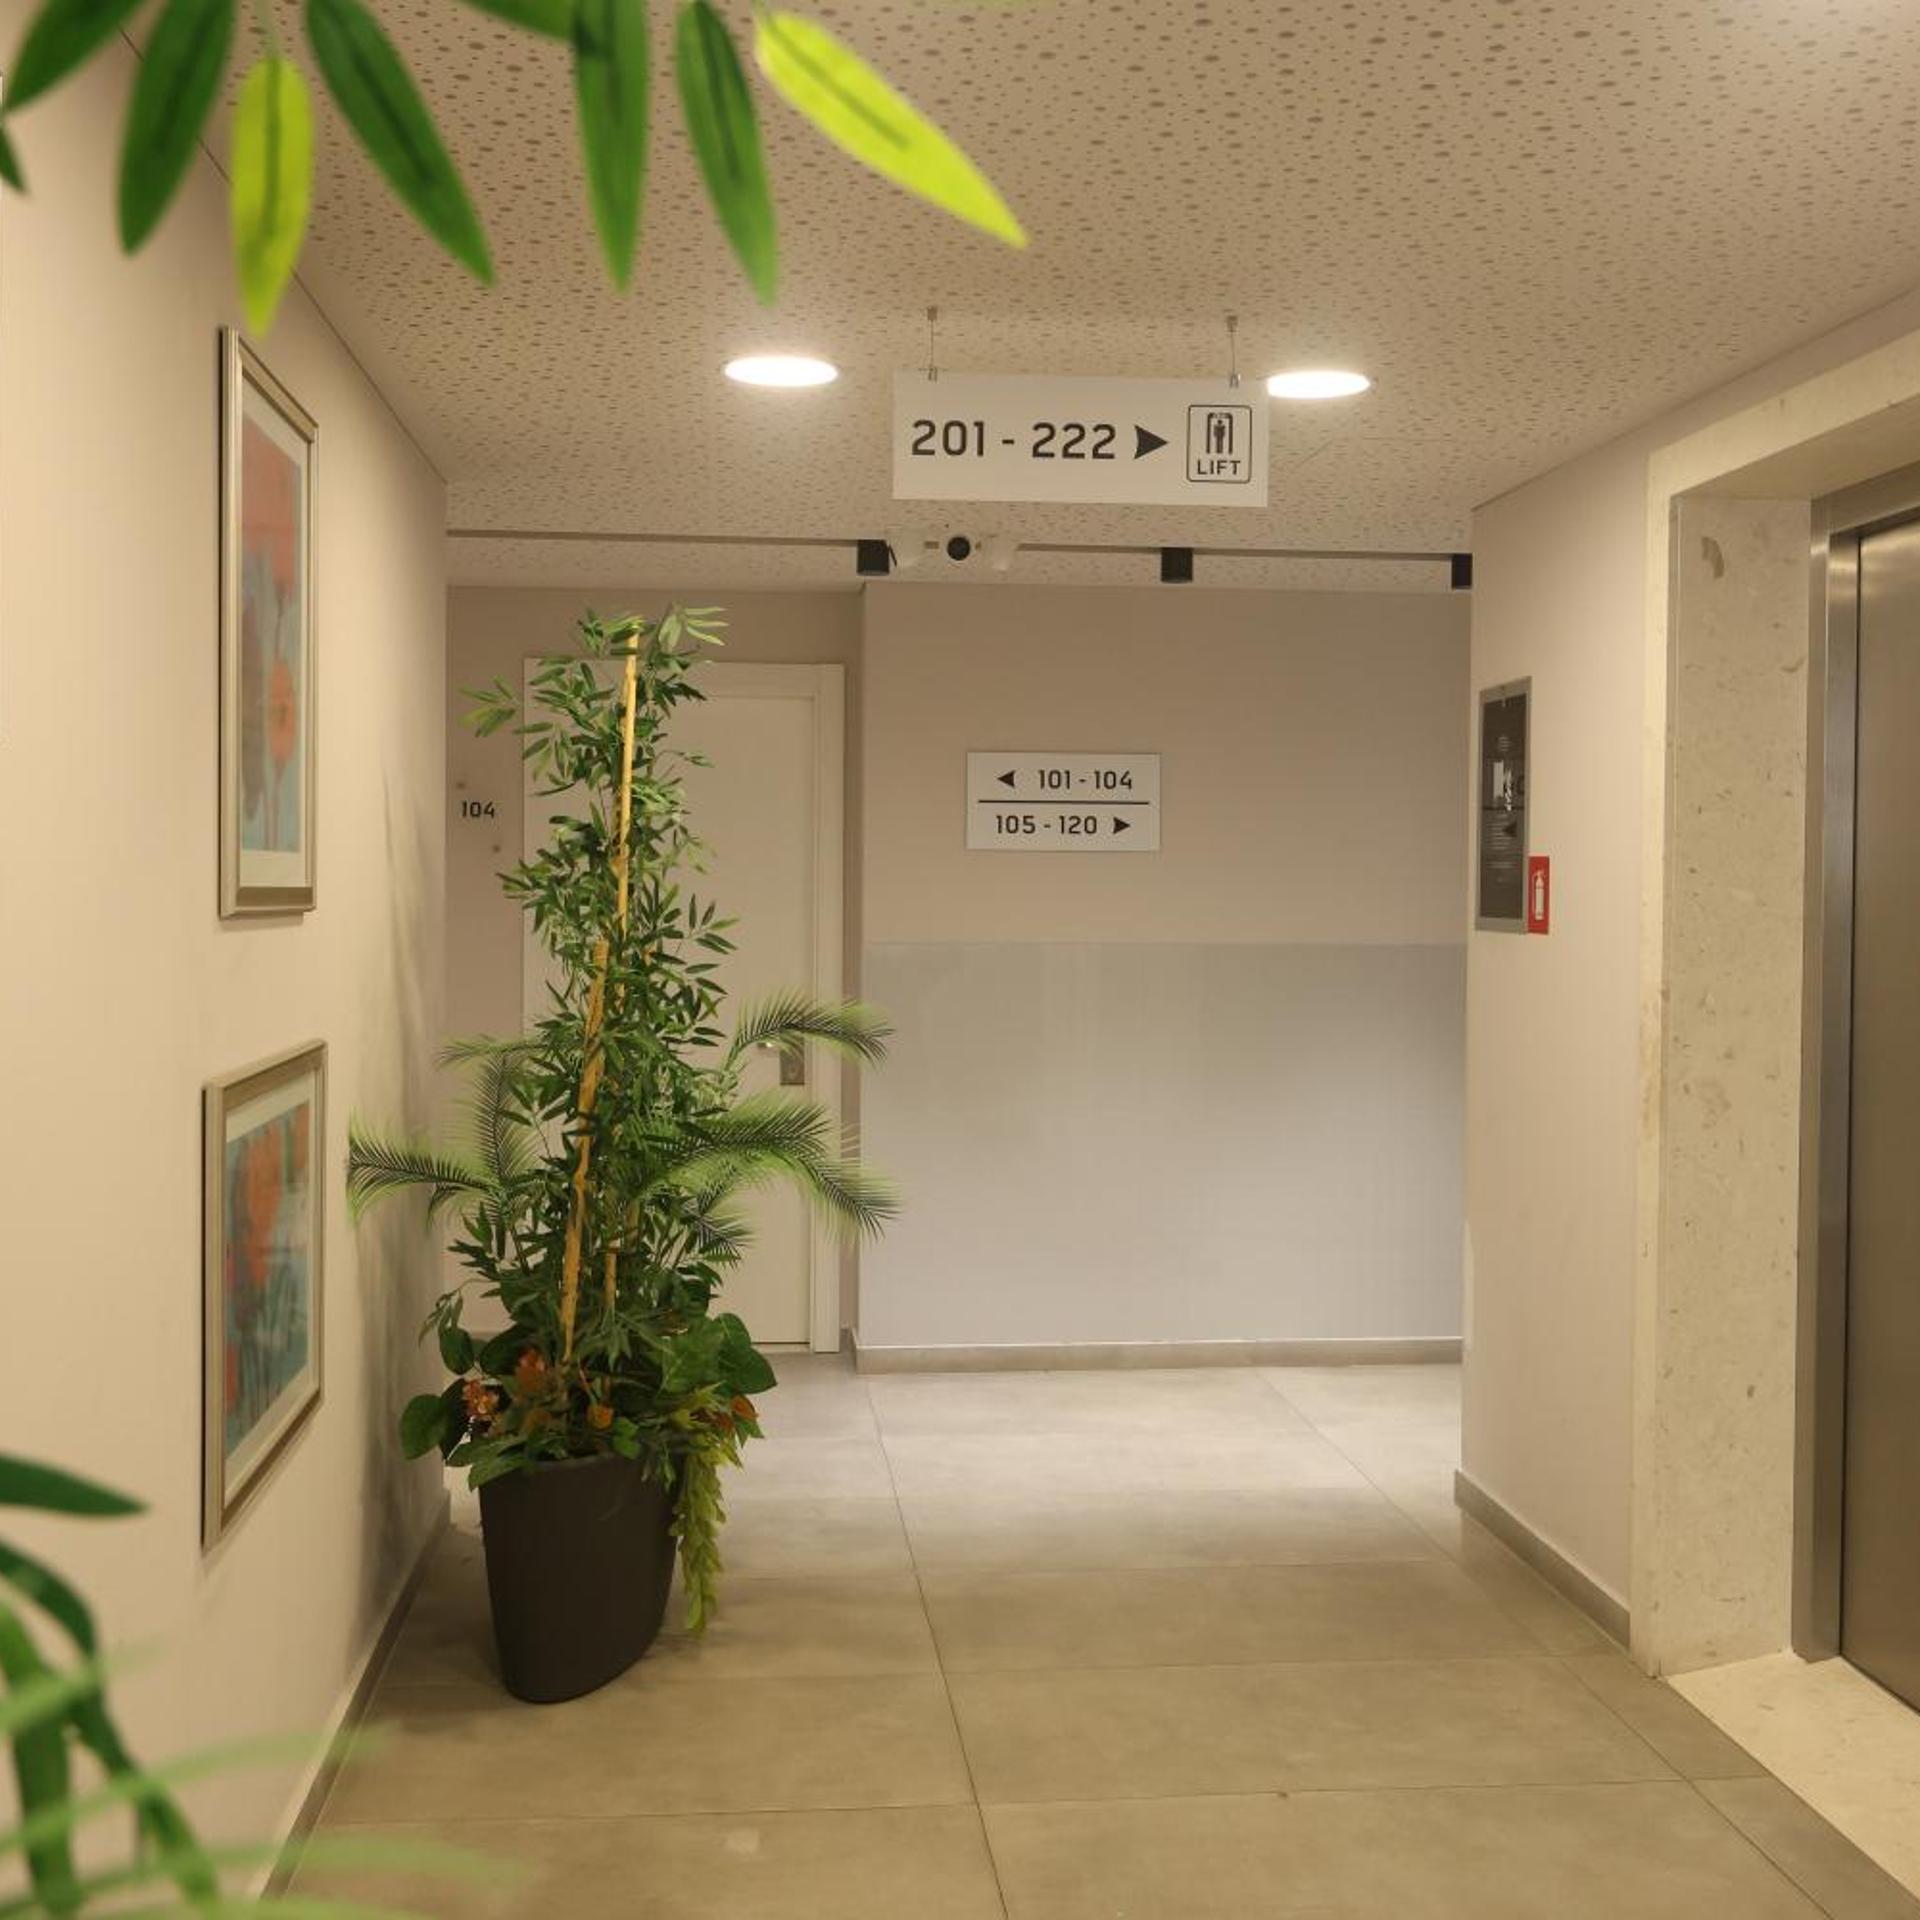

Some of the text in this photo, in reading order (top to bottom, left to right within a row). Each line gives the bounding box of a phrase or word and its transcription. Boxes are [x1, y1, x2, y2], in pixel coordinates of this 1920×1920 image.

[912, 419, 984, 456] 201
[1031, 422, 1117, 460] 222
[1196, 459, 1241, 476] LIFT
[1038, 769, 1071, 790] 101
[1094, 770, 1133, 790] 104
[462, 801, 495, 819] 104
[996, 815, 1036, 834] 105
[1059, 815, 1098, 835] 120
